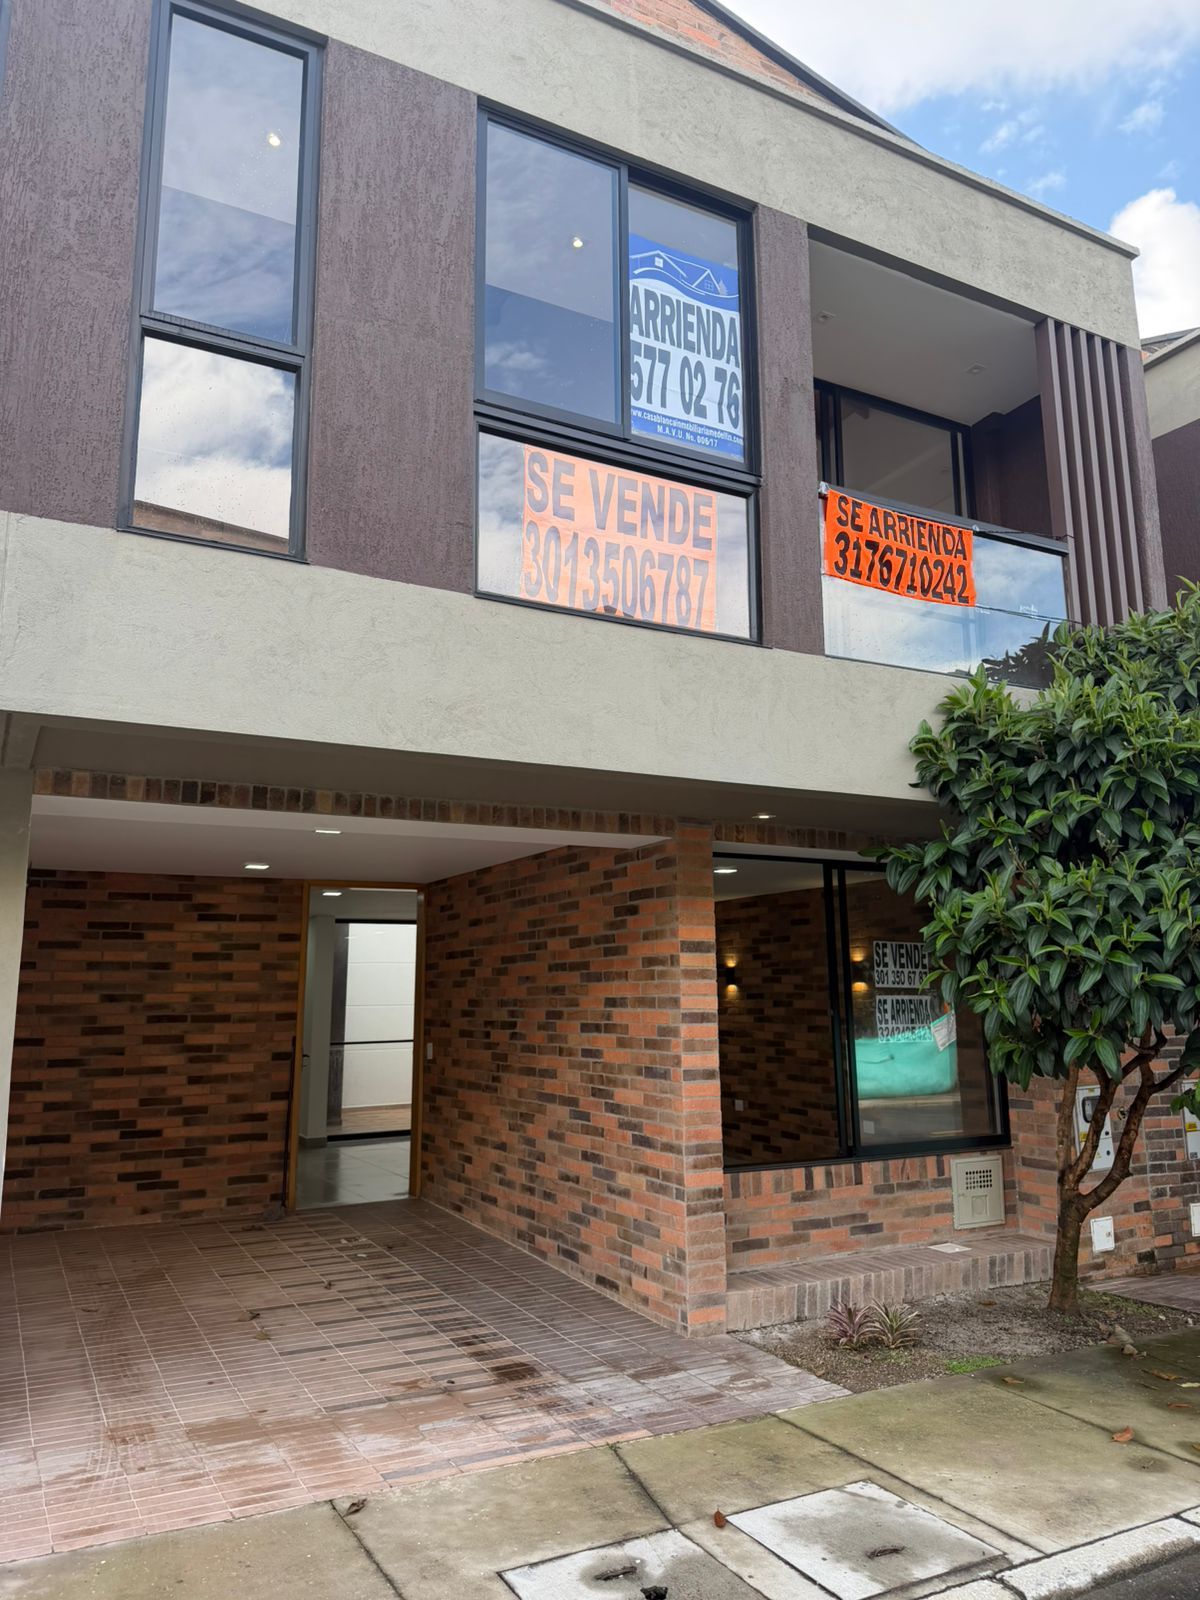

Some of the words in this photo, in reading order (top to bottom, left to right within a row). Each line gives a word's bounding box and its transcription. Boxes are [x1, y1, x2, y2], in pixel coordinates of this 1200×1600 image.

[630, 284, 740, 368] ARRIENDA
[631, 339, 671, 409] 577
[679, 355, 708, 420] 02
[714, 366, 741, 429] 76
[526, 451, 576, 522] SE
[589, 468, 713, 551] VENDE
[836, 495, 864, 533] SE
[869, 507, 968, 561] ARRIENDA
[523, 520, 710, 628] 3013506787
[833, 531, 970, 604] 3176710242
[875, 942, 889, 969] SE
[891, 943, 928, 970] VENDE
[875, 969, 889, 985] 301
[891, 970, 906, 986] 350
[907, 971, 917, 986] 67
[877, 998, 889, 1026] SE
[890, 998, 932, 1025] ARRIENDA
